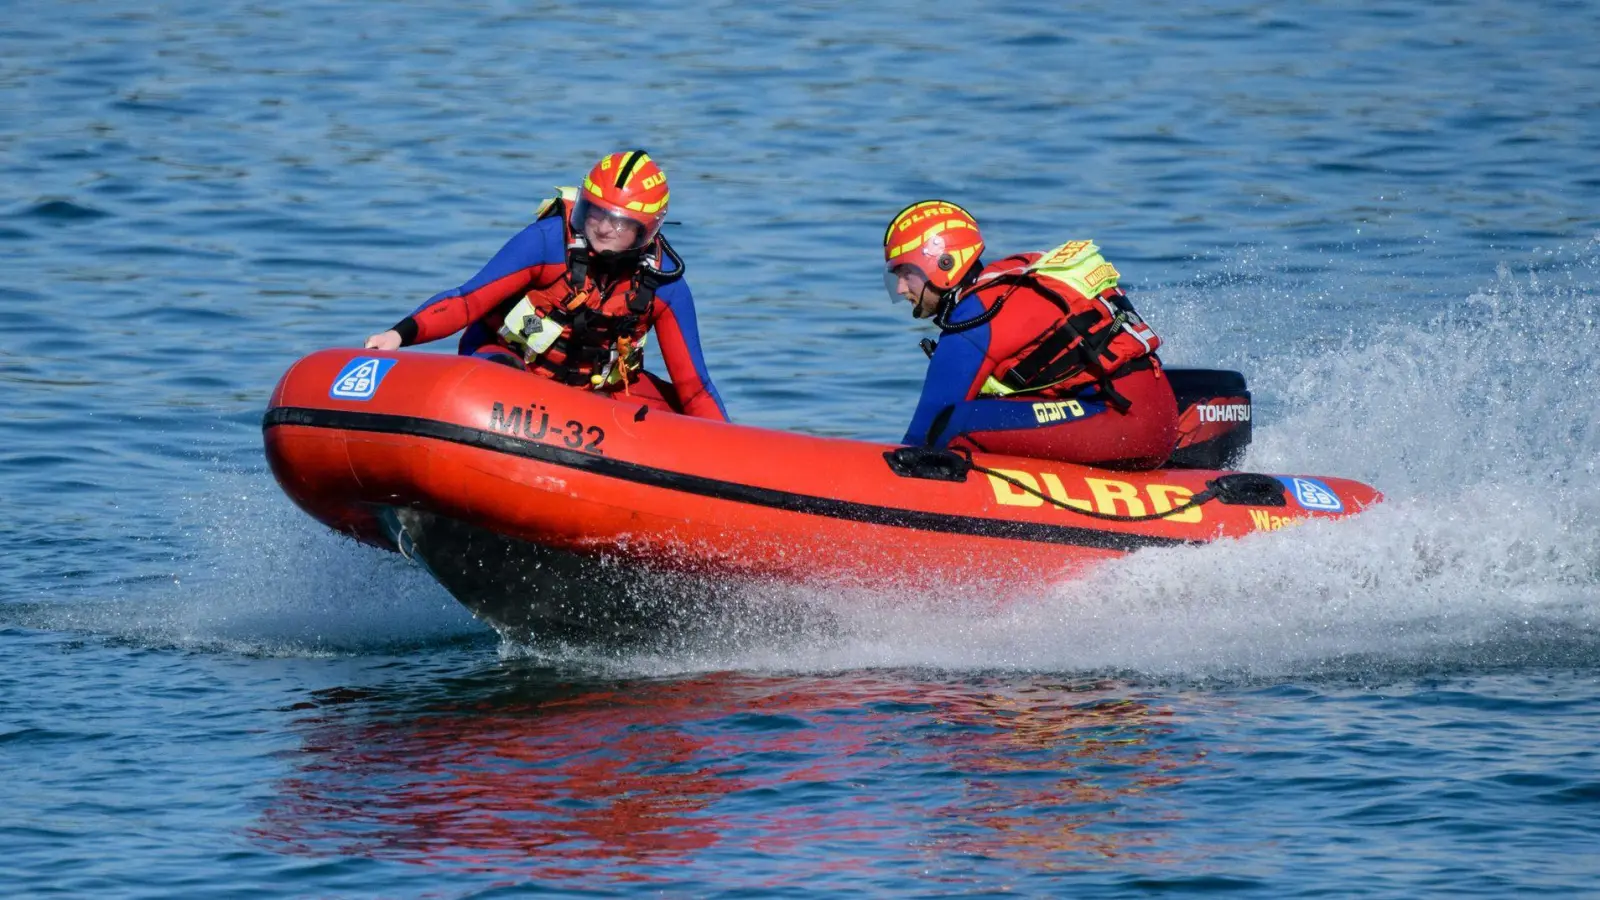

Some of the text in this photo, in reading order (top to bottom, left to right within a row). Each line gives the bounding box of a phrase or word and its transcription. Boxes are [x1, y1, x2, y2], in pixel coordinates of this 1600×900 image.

[898, 207, 954, 232] DLRG
[489, 401, 605, 455] MÜ-32
[1196, 404, 1250, 422] TOHATSU
[986, 467, 1203, 524] DLRG
